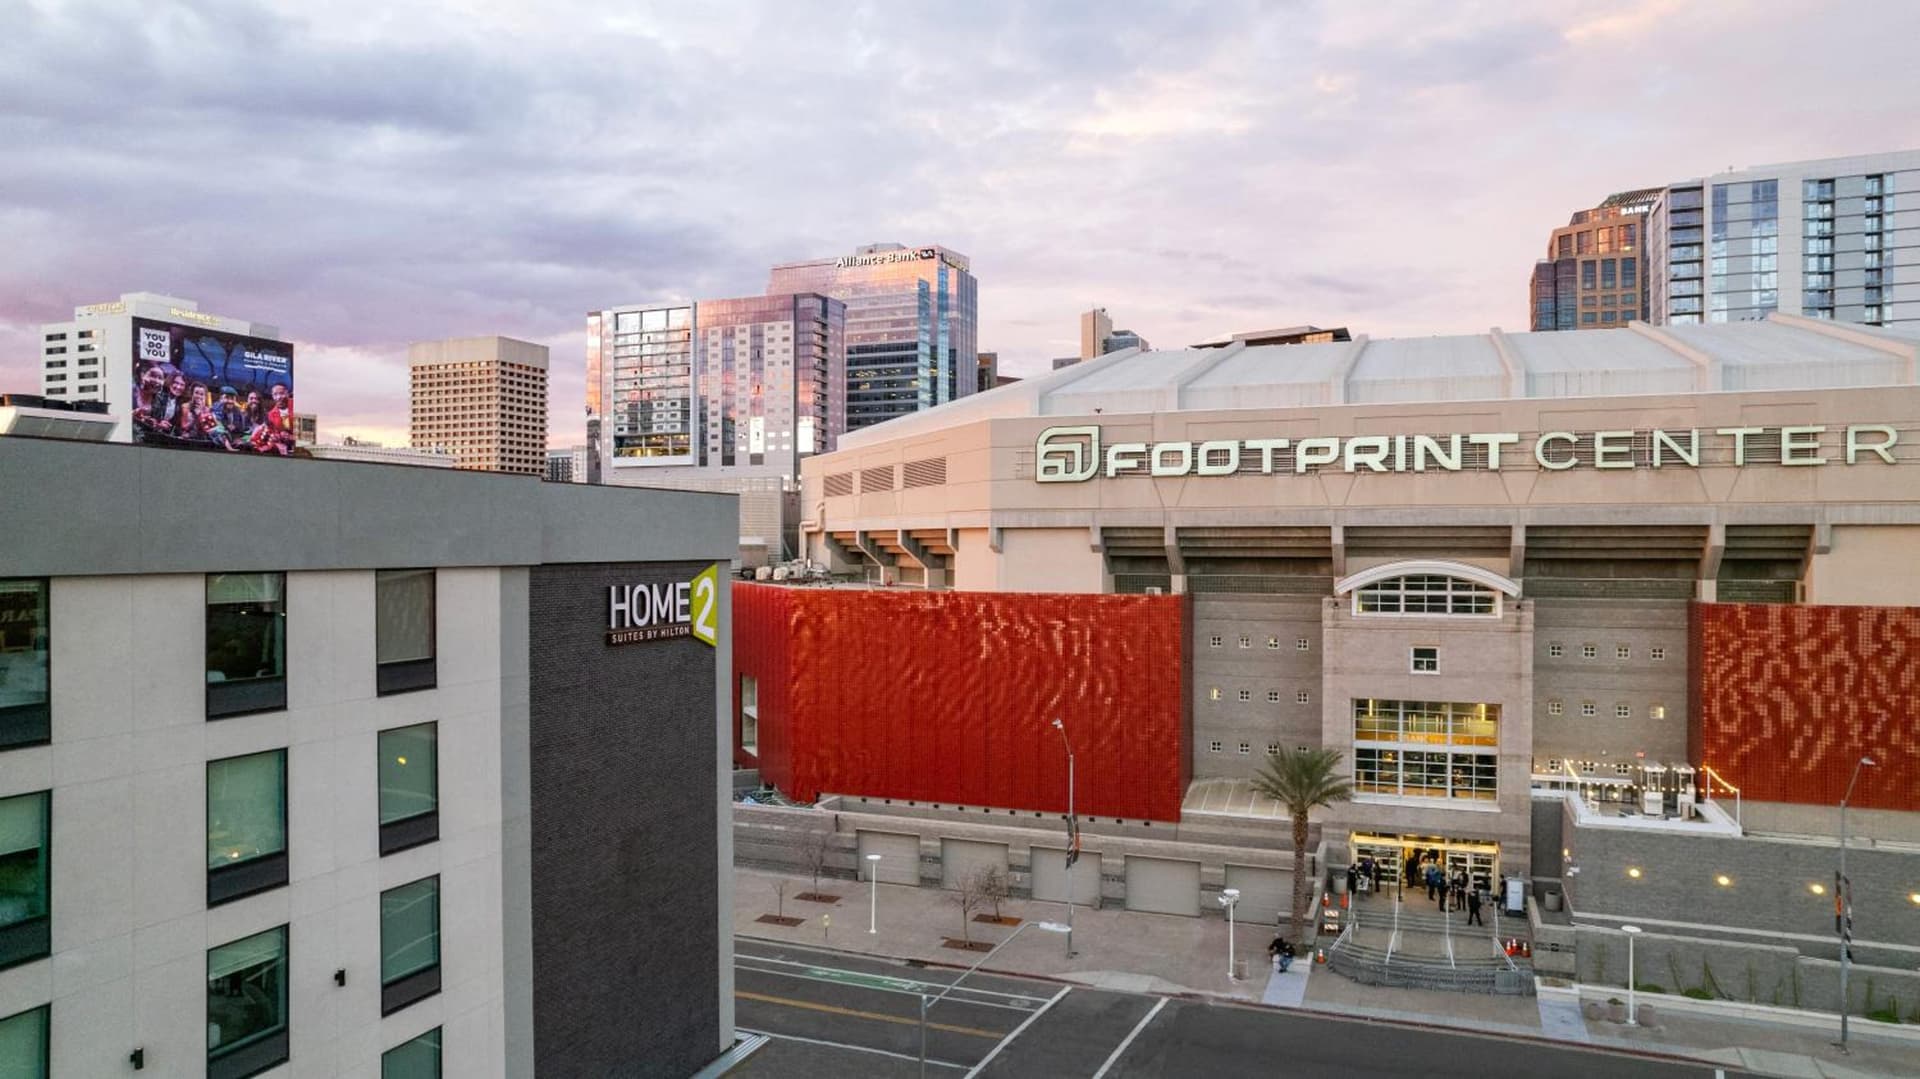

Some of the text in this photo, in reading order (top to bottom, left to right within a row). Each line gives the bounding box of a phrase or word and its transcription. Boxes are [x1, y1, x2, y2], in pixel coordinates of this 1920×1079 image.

[1621, 205, 1649, 215] BANK
[836, 251, 918, 268] Alliance Bank
[144, 332, 166, 343] YOU
[147, 341, 162, 350] DO
[145, 348, 166, 358] YOU
[244, 351, 263, 360] GILA
[1106, 424, 1898, 478] FOOTPRINT CENTER
[610, 576, 715, 641] HOME 2
[612, 626, 690, 644] SUITES BY HILTON
